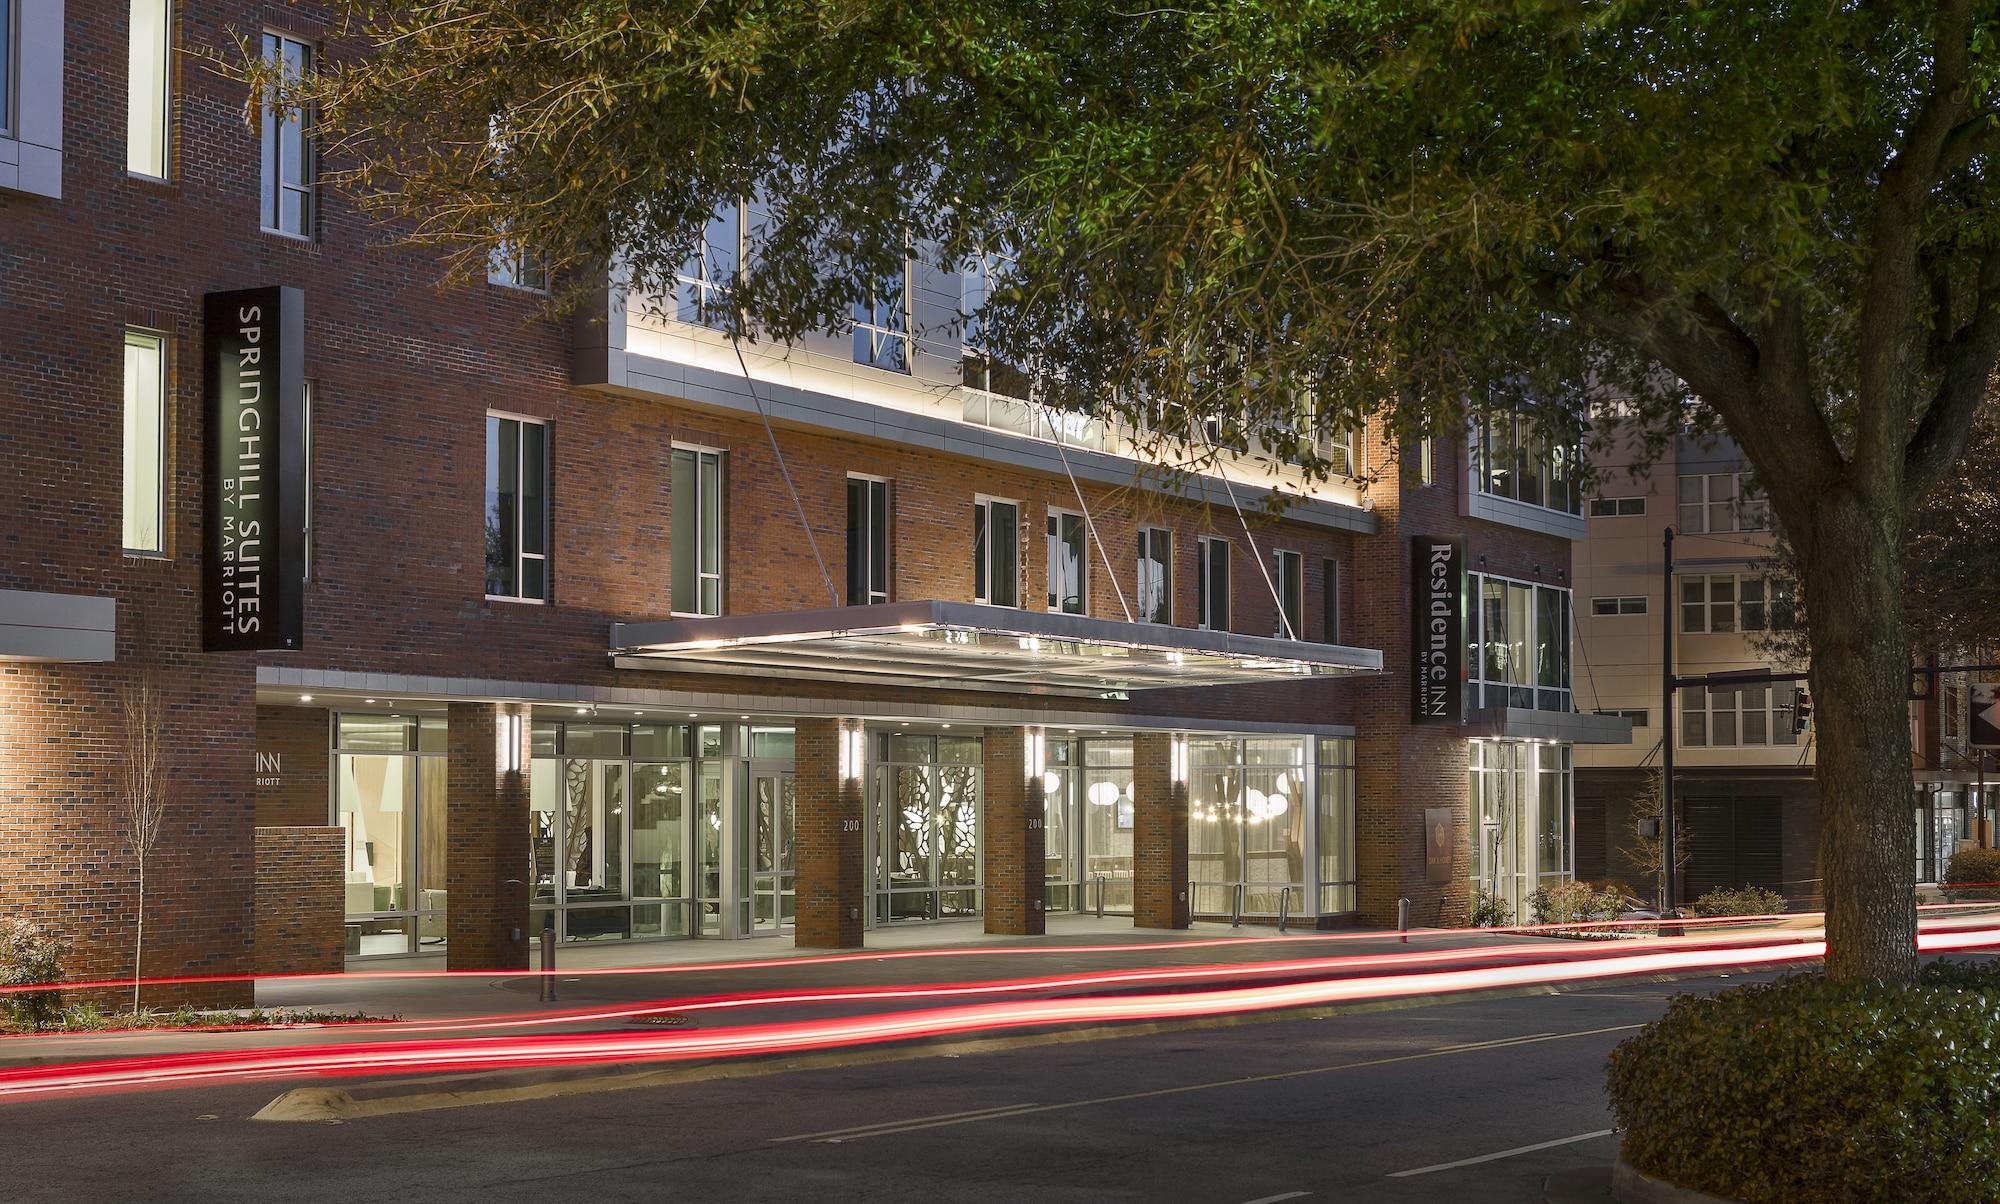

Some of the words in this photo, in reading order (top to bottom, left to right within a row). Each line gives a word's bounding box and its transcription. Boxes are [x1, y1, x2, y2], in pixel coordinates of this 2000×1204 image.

[239, 305, 261, 509] SPRINGHILL
[223, 478, 235, 505] BY
[222, 516, 235, 635] MARRIOTT
[238, 520, 261, 634] SUITES
[1430, 544, 1452, 681] Residence
[1420, 651, 1428, 663] BY
[1420, 666, 1428, 716] MARRIOTT
[1430, 686, 1447, 716] INN
[256, 751, 281, 773] INN
[843, 819, 860, 831] 200
[1028, 818, 1042, 829] 200
